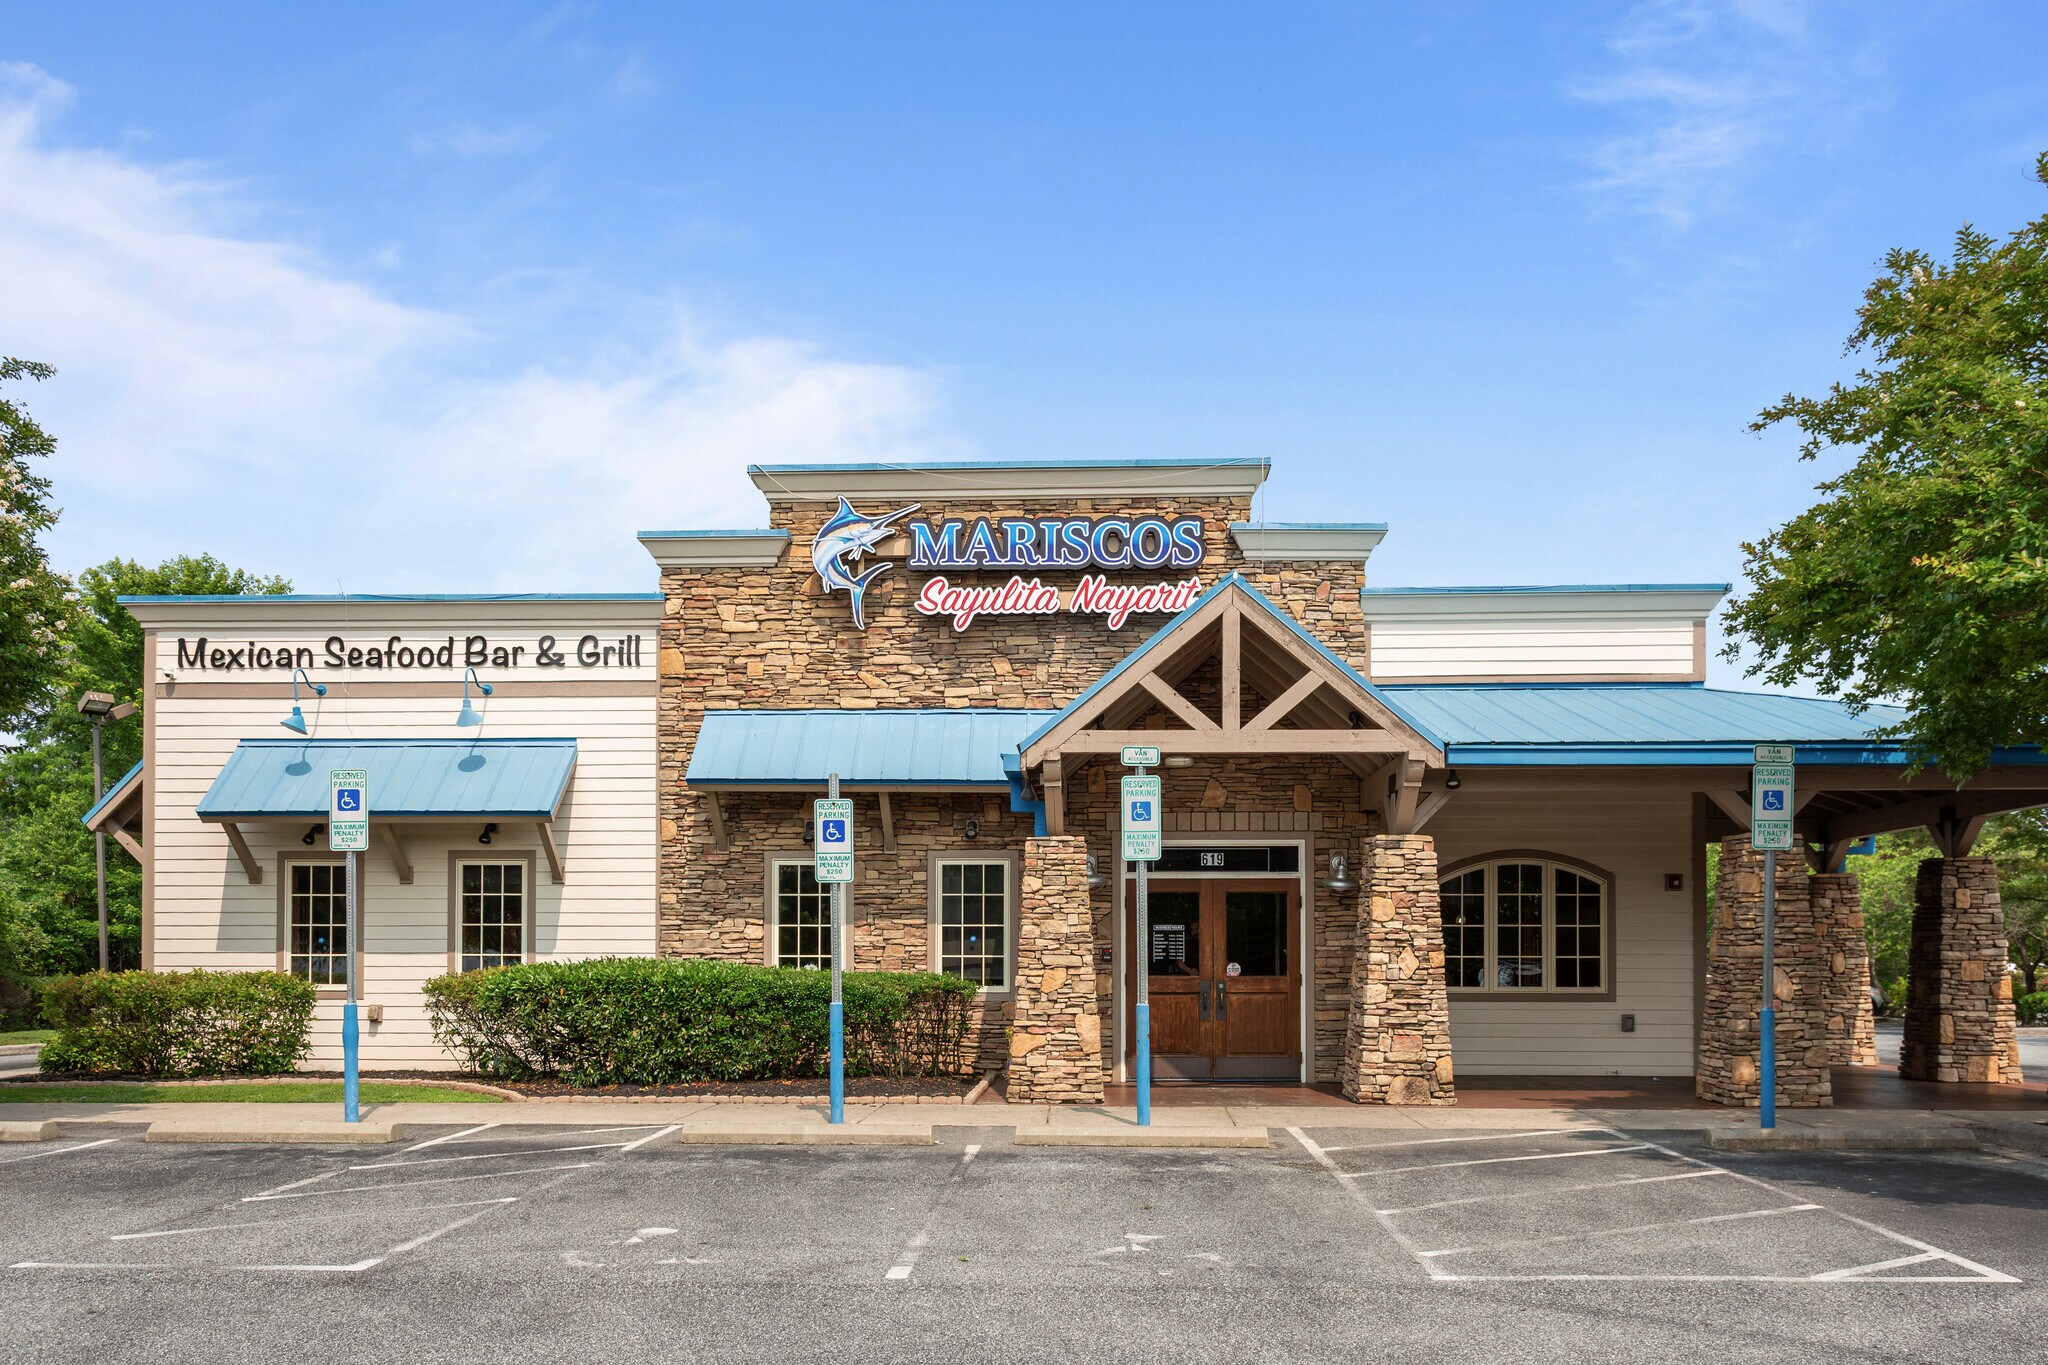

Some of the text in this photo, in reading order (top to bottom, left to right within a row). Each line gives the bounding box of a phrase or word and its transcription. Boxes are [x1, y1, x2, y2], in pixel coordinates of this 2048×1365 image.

[910, 520, 1202, 566] MARISCOS
[916, 577, 1200, 631] Sayulita Nayarit
[178, 634, 640, 669] Mexican Seafood Bar & Grill
[333, 772, 364, 780] RESERVED
[1124, 780, 1157, 788] RESERVED
[1202, 853, 1223, 866] 619
